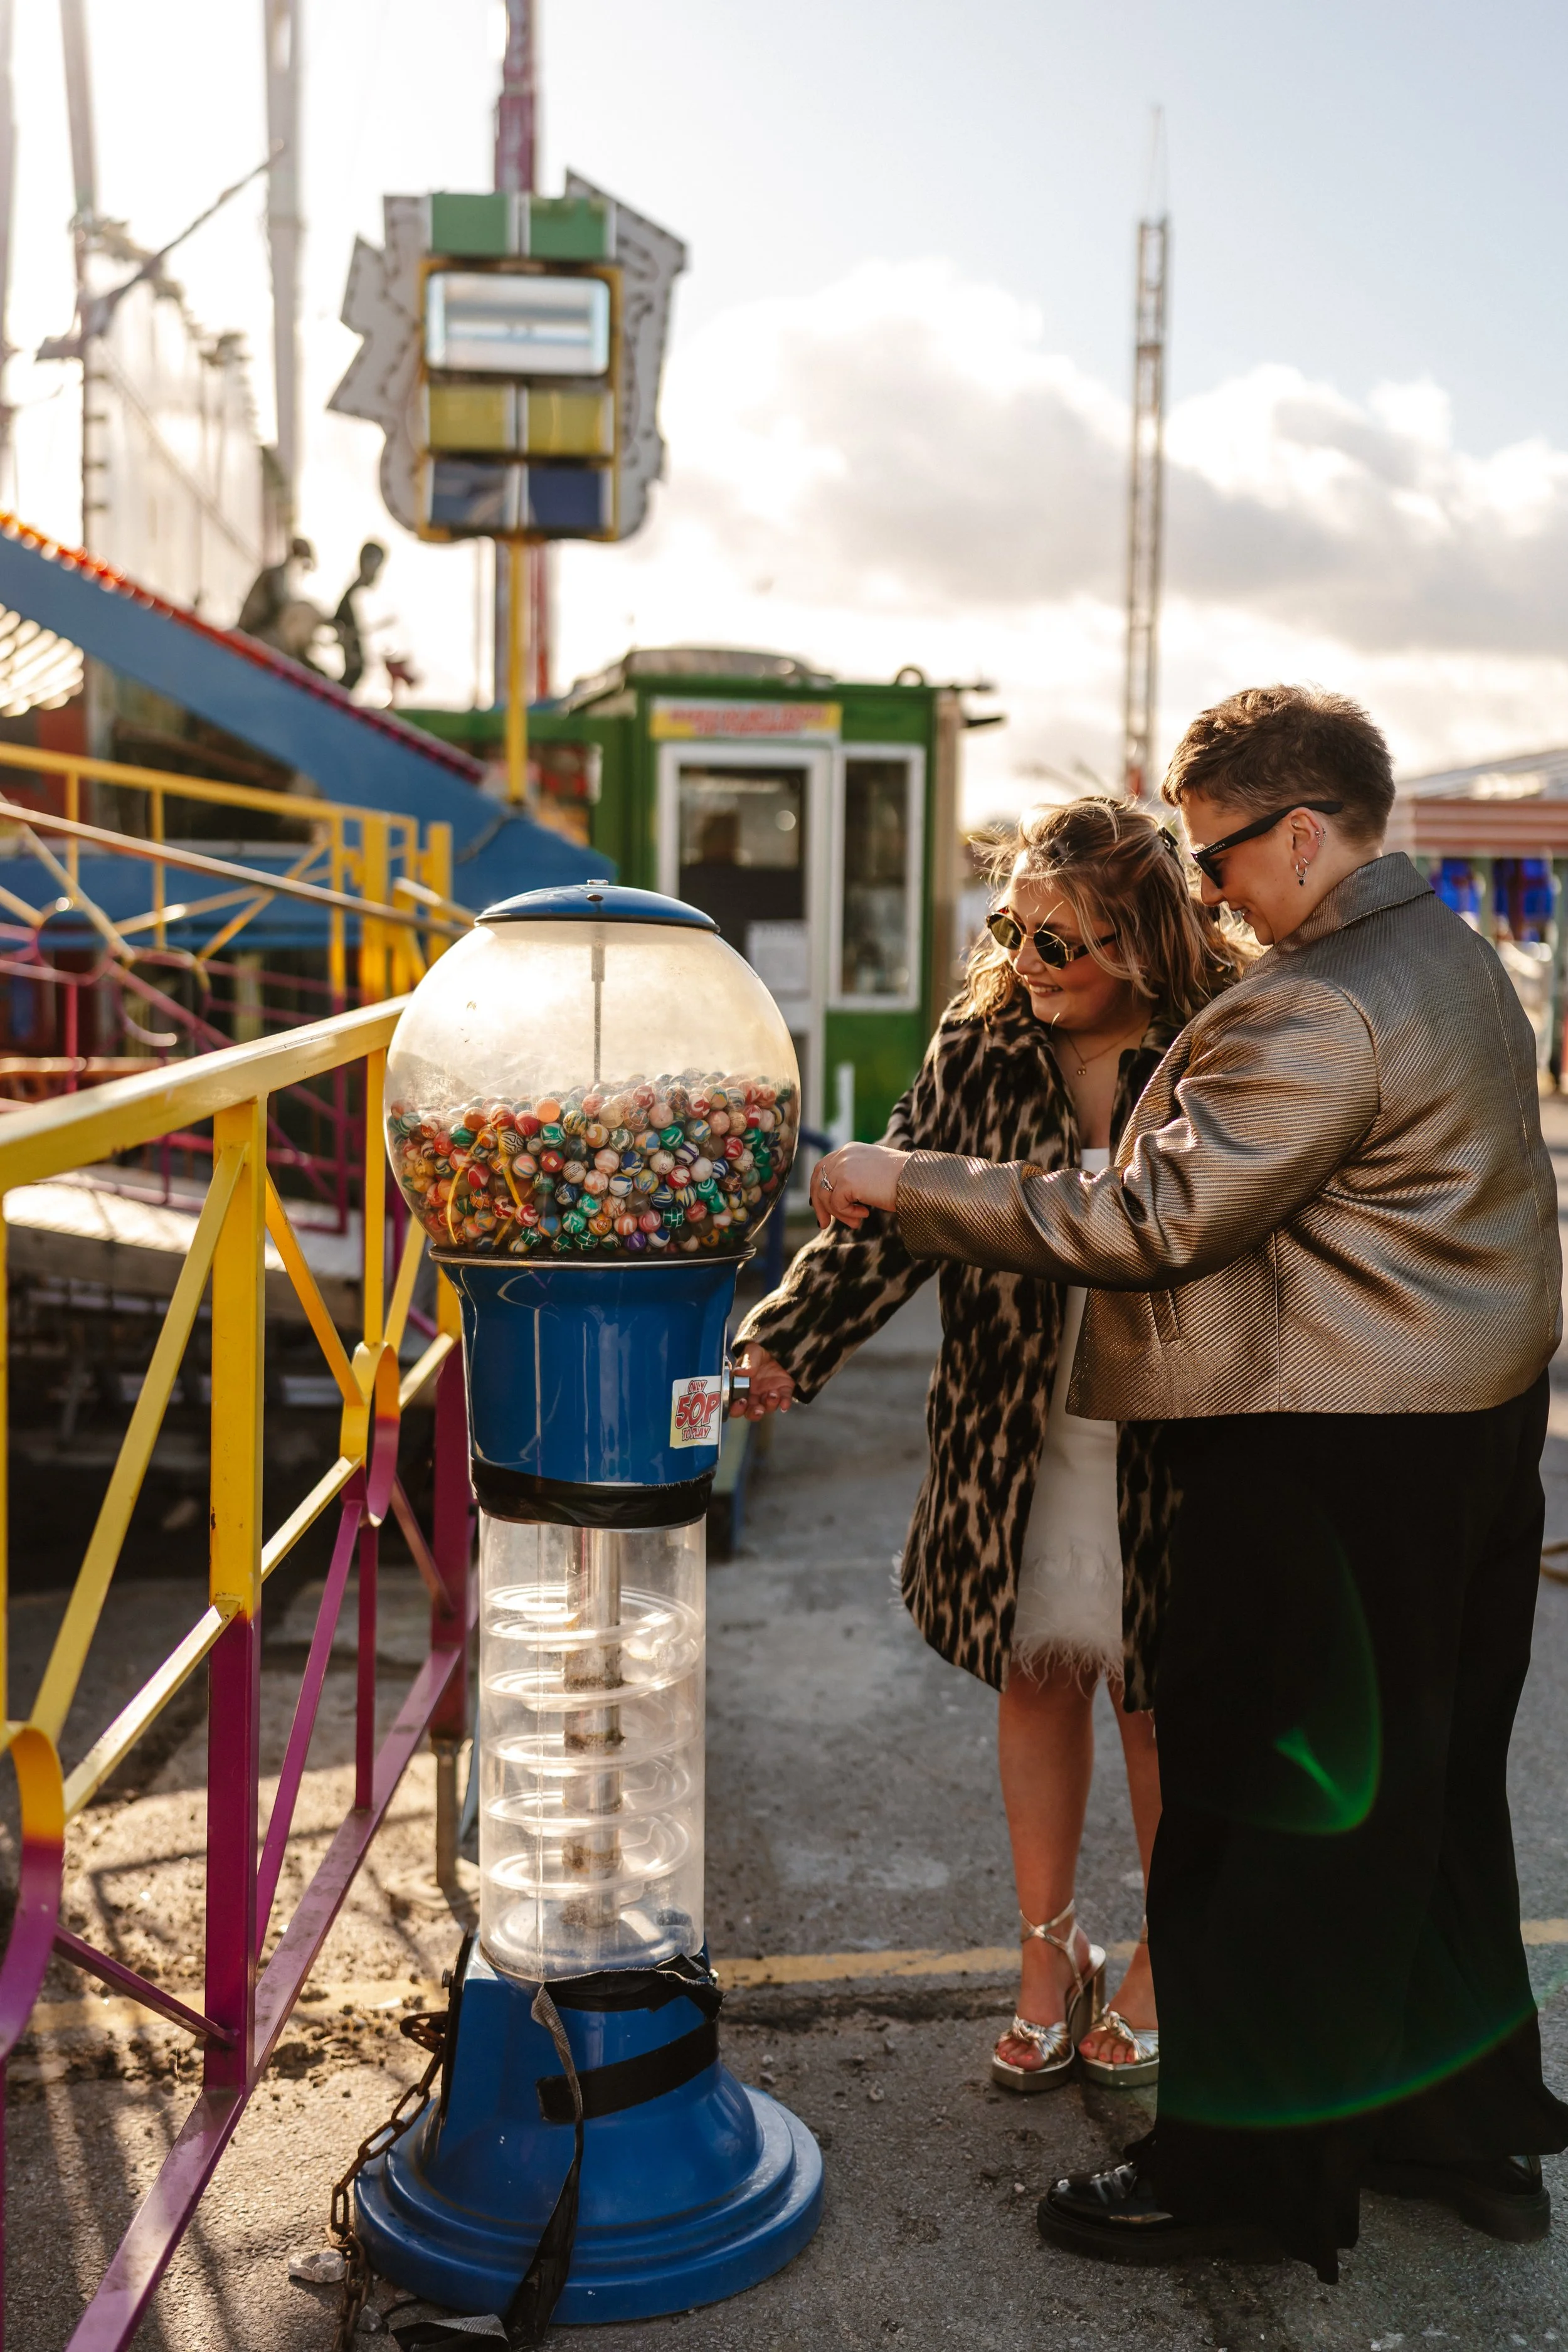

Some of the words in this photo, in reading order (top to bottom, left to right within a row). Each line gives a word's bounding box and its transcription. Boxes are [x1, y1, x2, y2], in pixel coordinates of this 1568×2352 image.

[1209, 843, 1226, 853] LUENX
[687, 1380, 707, 1394] ONLY
[675, 1391, 721, 1428] 50P
[682, 1428, 691, 1441] TO
[690, 1426, 711, 1439] PLAY
